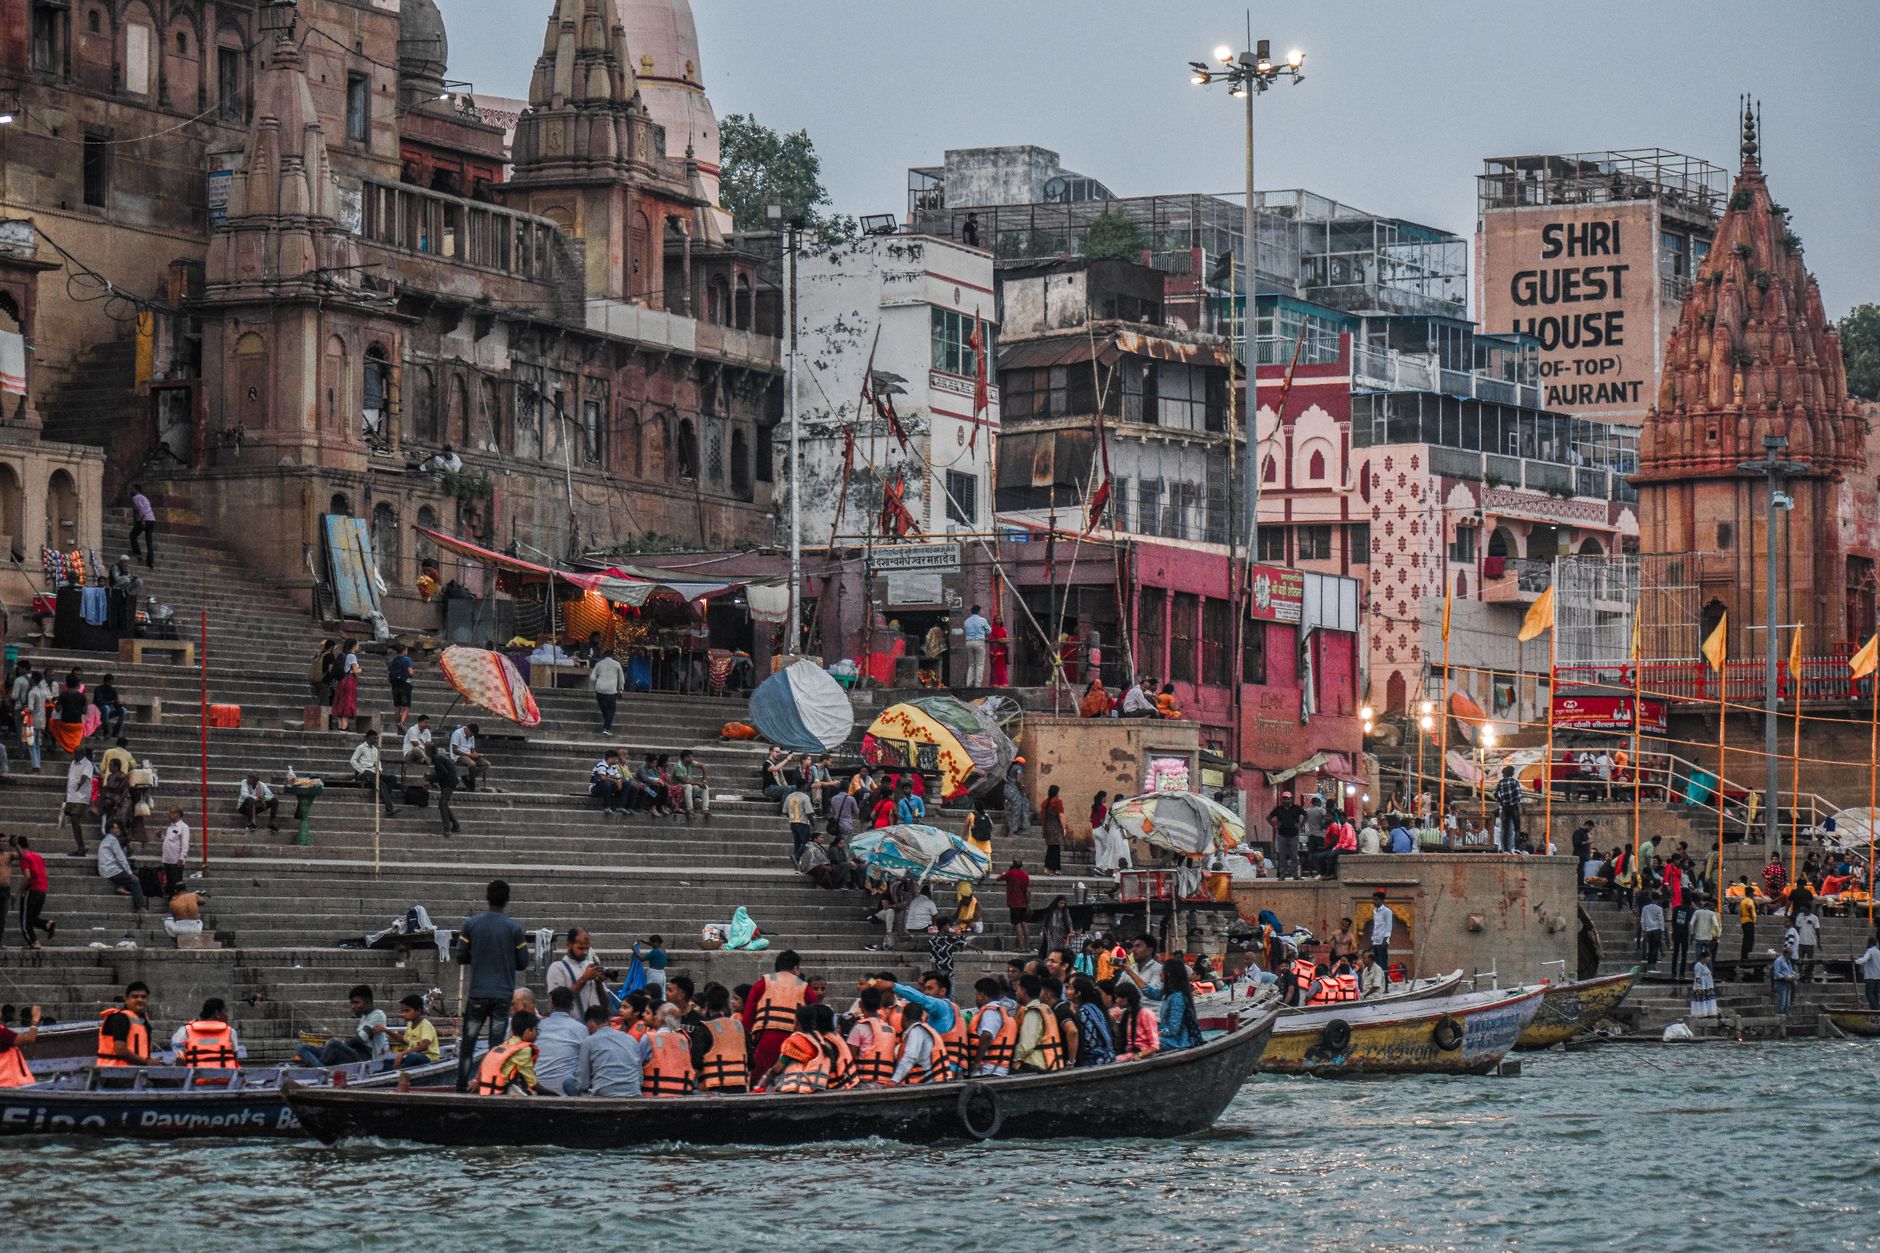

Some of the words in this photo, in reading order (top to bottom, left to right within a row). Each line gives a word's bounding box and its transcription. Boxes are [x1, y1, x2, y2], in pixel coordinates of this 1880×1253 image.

[1542, 220, 1620, 259] SHRI
[1511, 264, 1629, 307] GUEST
[1544, 380, 1643, 406] AURANT
[927, 553, 957, 565] महादेव
